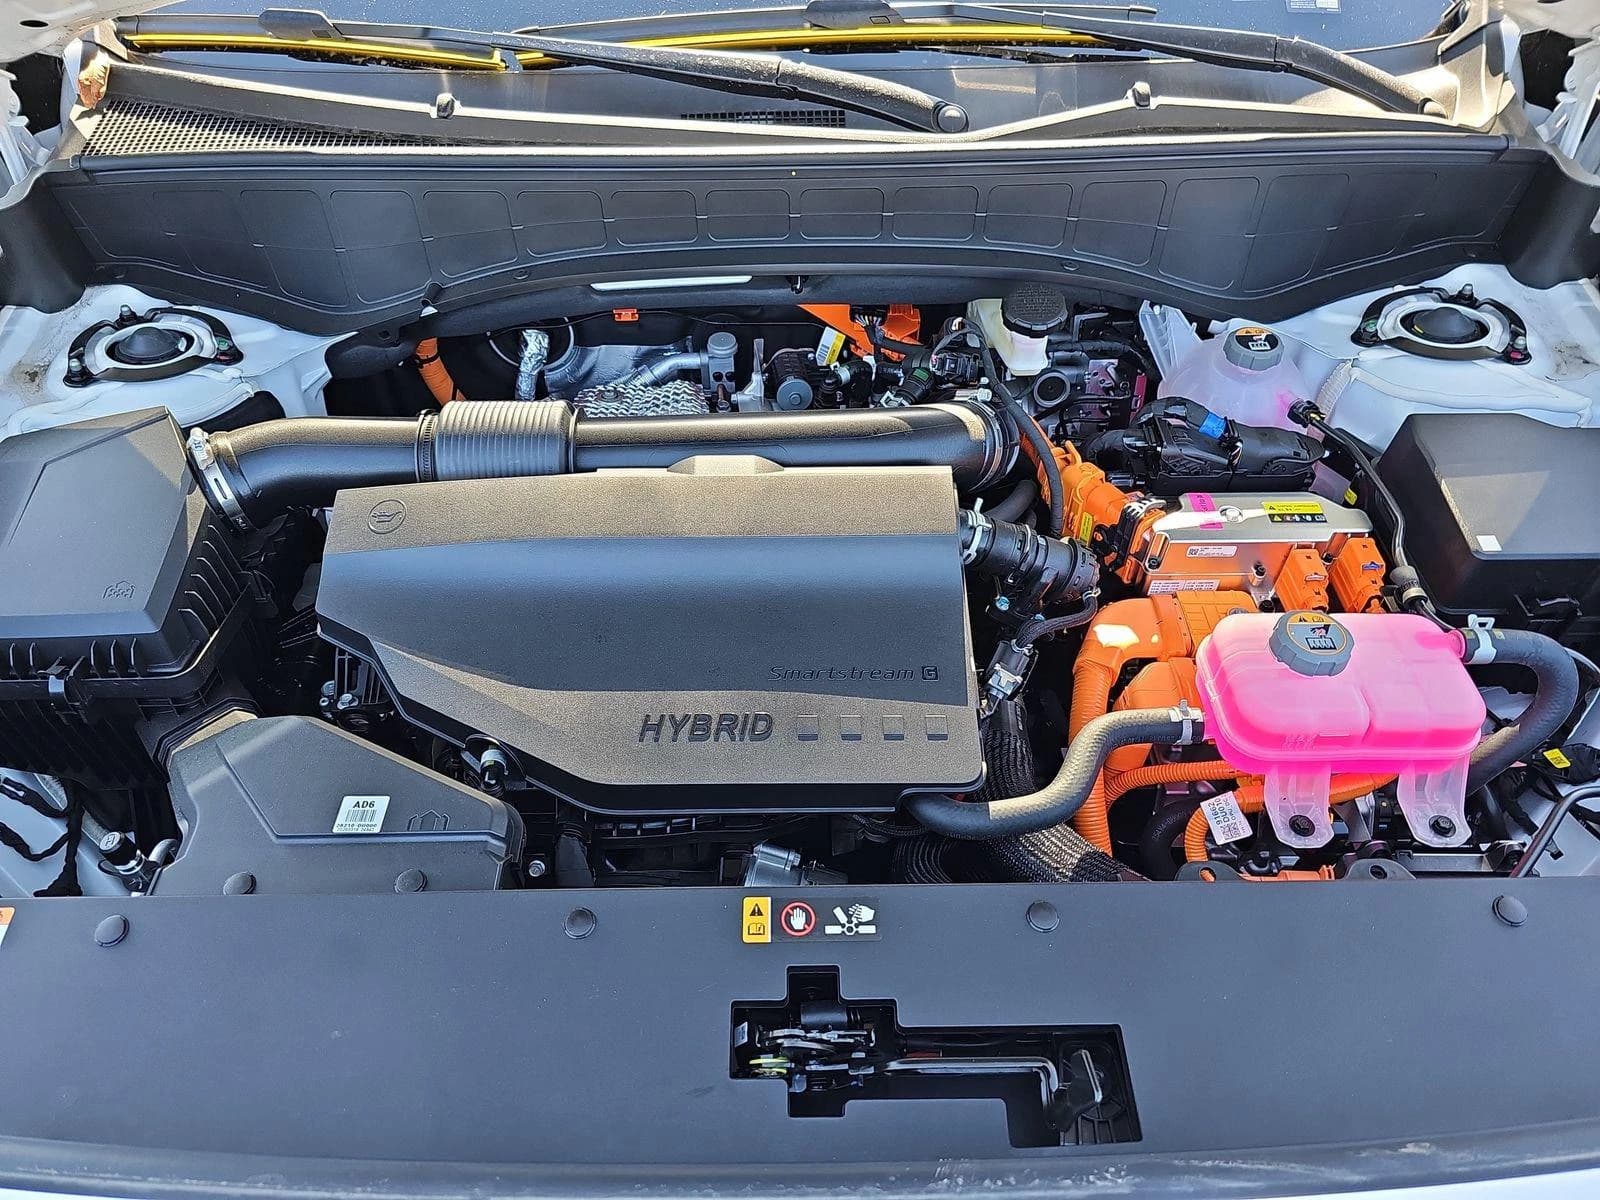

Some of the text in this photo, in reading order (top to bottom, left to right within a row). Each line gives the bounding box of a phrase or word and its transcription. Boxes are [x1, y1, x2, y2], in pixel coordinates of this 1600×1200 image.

[768, 665, 938, 681] Smartstream G
[638, 712, 774, 742] HYBRID
[353, 800, 375, 808] AD6
[1208, 802, 1223, 825] 91662
